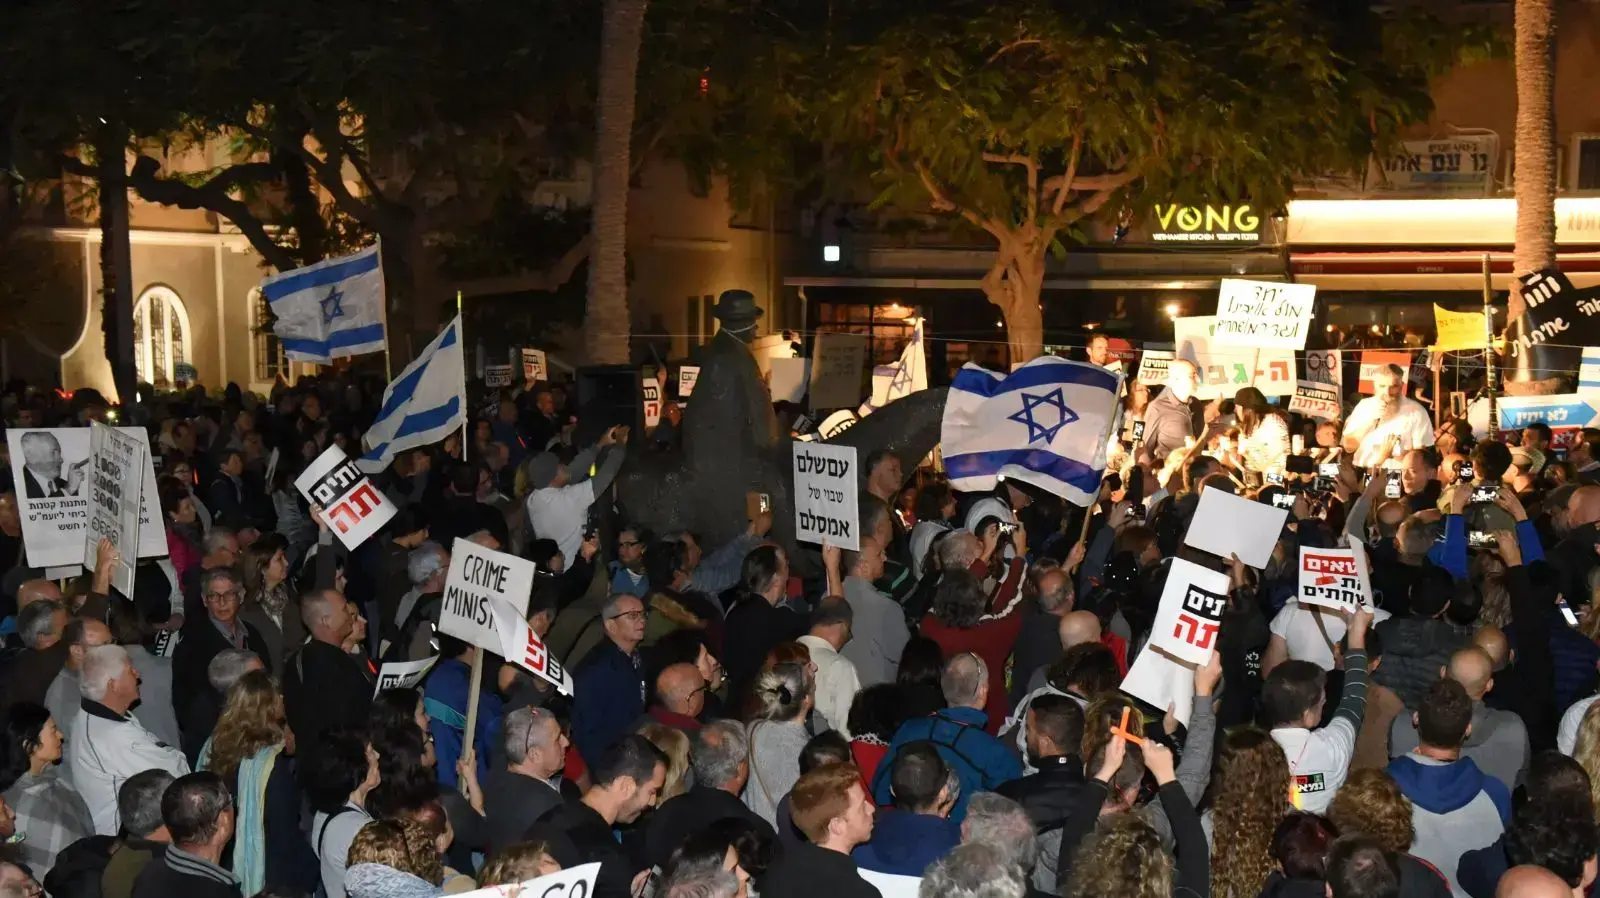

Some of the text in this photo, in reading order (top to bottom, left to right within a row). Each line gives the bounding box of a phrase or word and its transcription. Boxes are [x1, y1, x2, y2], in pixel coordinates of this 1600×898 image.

[1154, 204, 1259, 231] VONG
[1274, 299, 1302, 318] מול
[1547, 408, 1569, 421] לא
[808, 484, 844, 503] שבוי של
[28, 500, 87, 511] מתנות קטנות
[68, 511, 87, 519] ביחי
[799, 508, 850, 538] אמסלם
[463, 554, 510, 594] CRIME
[1306, 558, 1357, 574] טאים
[1303, 585, 1366, 606] שחתים
[1245, 651, 1259, 661] לא
